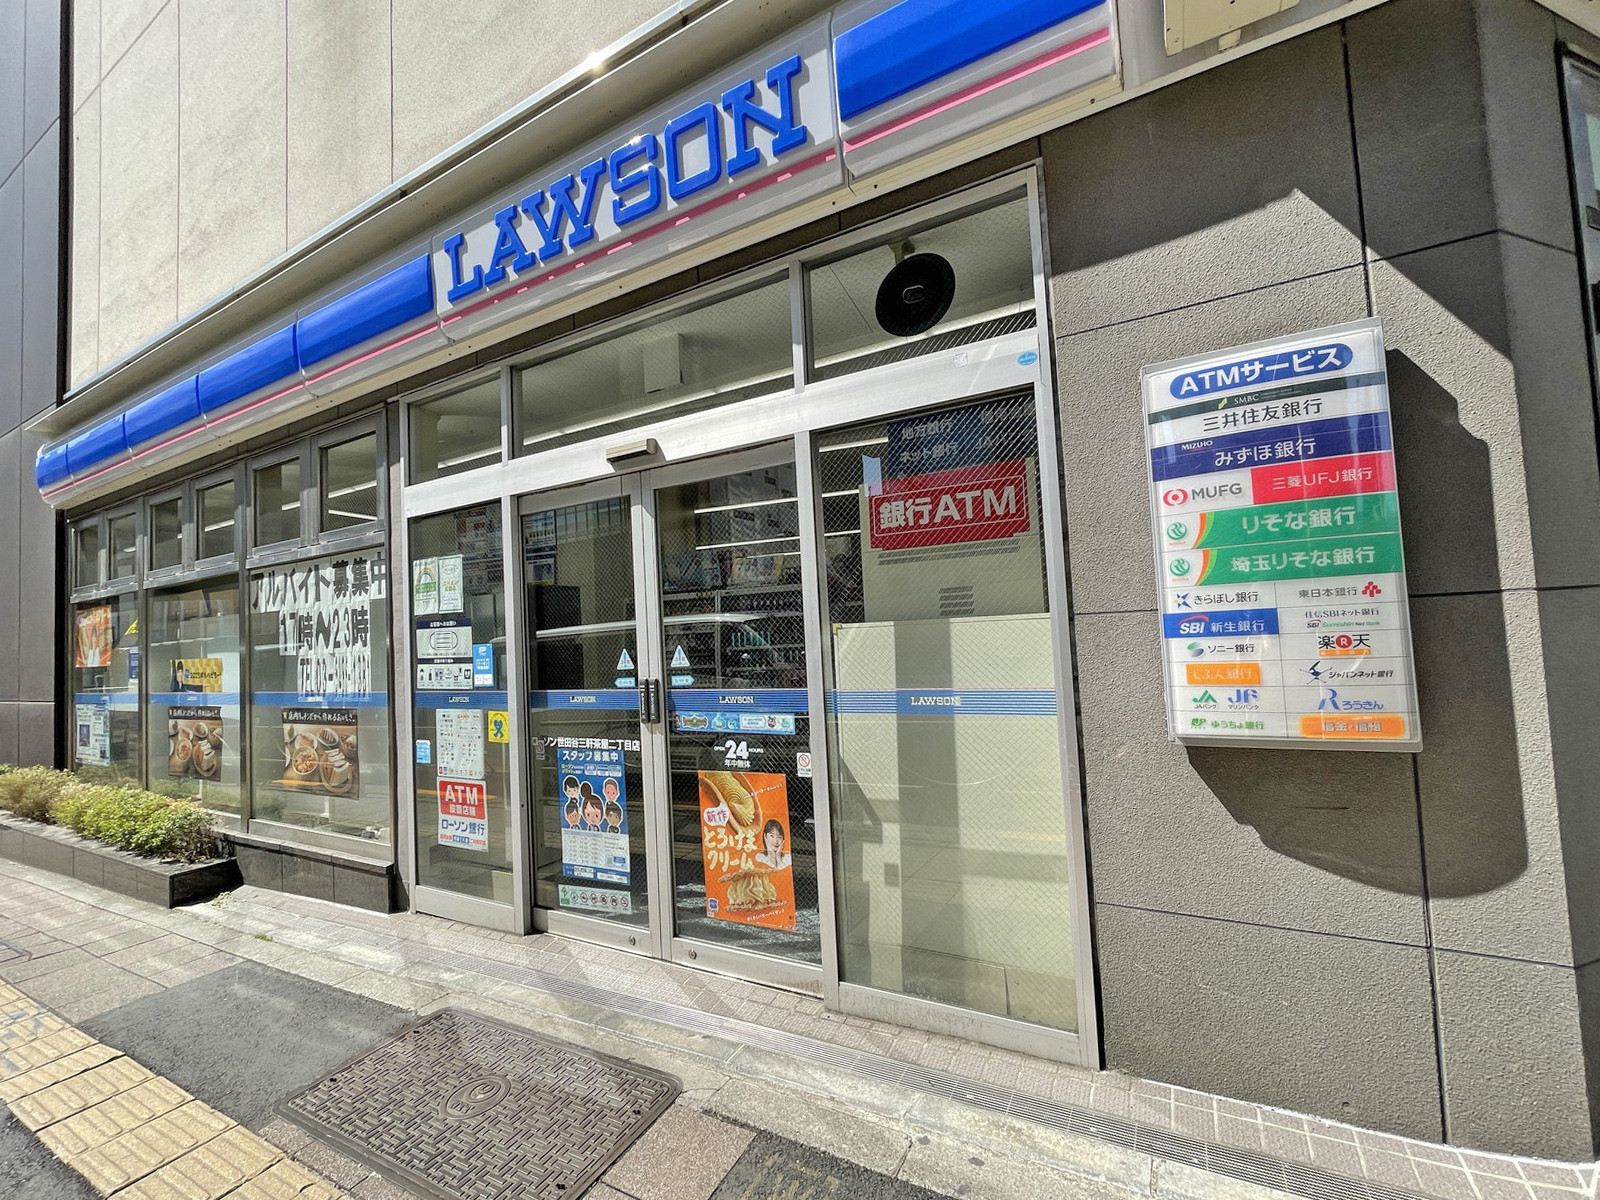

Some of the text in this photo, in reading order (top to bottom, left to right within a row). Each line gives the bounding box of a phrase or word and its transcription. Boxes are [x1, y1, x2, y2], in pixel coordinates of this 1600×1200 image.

[443, 54, 807, 302] LAWSON
[1179, 347, 1342, 395] ATMサービス
[1234, 393, 1260, 405] SMBC
[1203, 398, 1322, 432] 三井住友銀行
[1181, 440, 1213, 451] MIZUHO
[1214, 438, 1316, 467] みずほ銀行
[1272, 466, 1373, 491] 三菱UFJ銀行
[1191, 483, 1242, 500] MUFG
[879, 485, 1017, 529] 銀行ATM
[1242, 506, 1356, 534] りそな銀行
[1231, 547, 1376, 573] 埼玉りそな銀行
[251, 551, 387, 610] アルバイト募集中
[1194, 591, 1258, 606] きらぼし銀行
[1299, 587, 1358, 599] 東日本銀行
[1305, 607, 1380, 619] 住信SBIネット銀行
[1179, 618, 1265, 635] SBI 新生銀行
[1207, 643, 1255, 655] ソニー銀行
[1329, 670, 1394, 679] ジャパンネット銀行
[718, 696, 755, 704] LAWSON
[910, 696, 962, 706] LAWSON
[1342, 700, 1384, 711] ろうきん
[562, 750, 619, 762] スタッフ募集中
[725, 739, 749, 759] 24
[445, 784, 478, 806] ATM
[706, 809, 727, 823] 新作
[441, 819, 485, 836] ローソン銀行
[707, 850, 755, 872] クリーム
